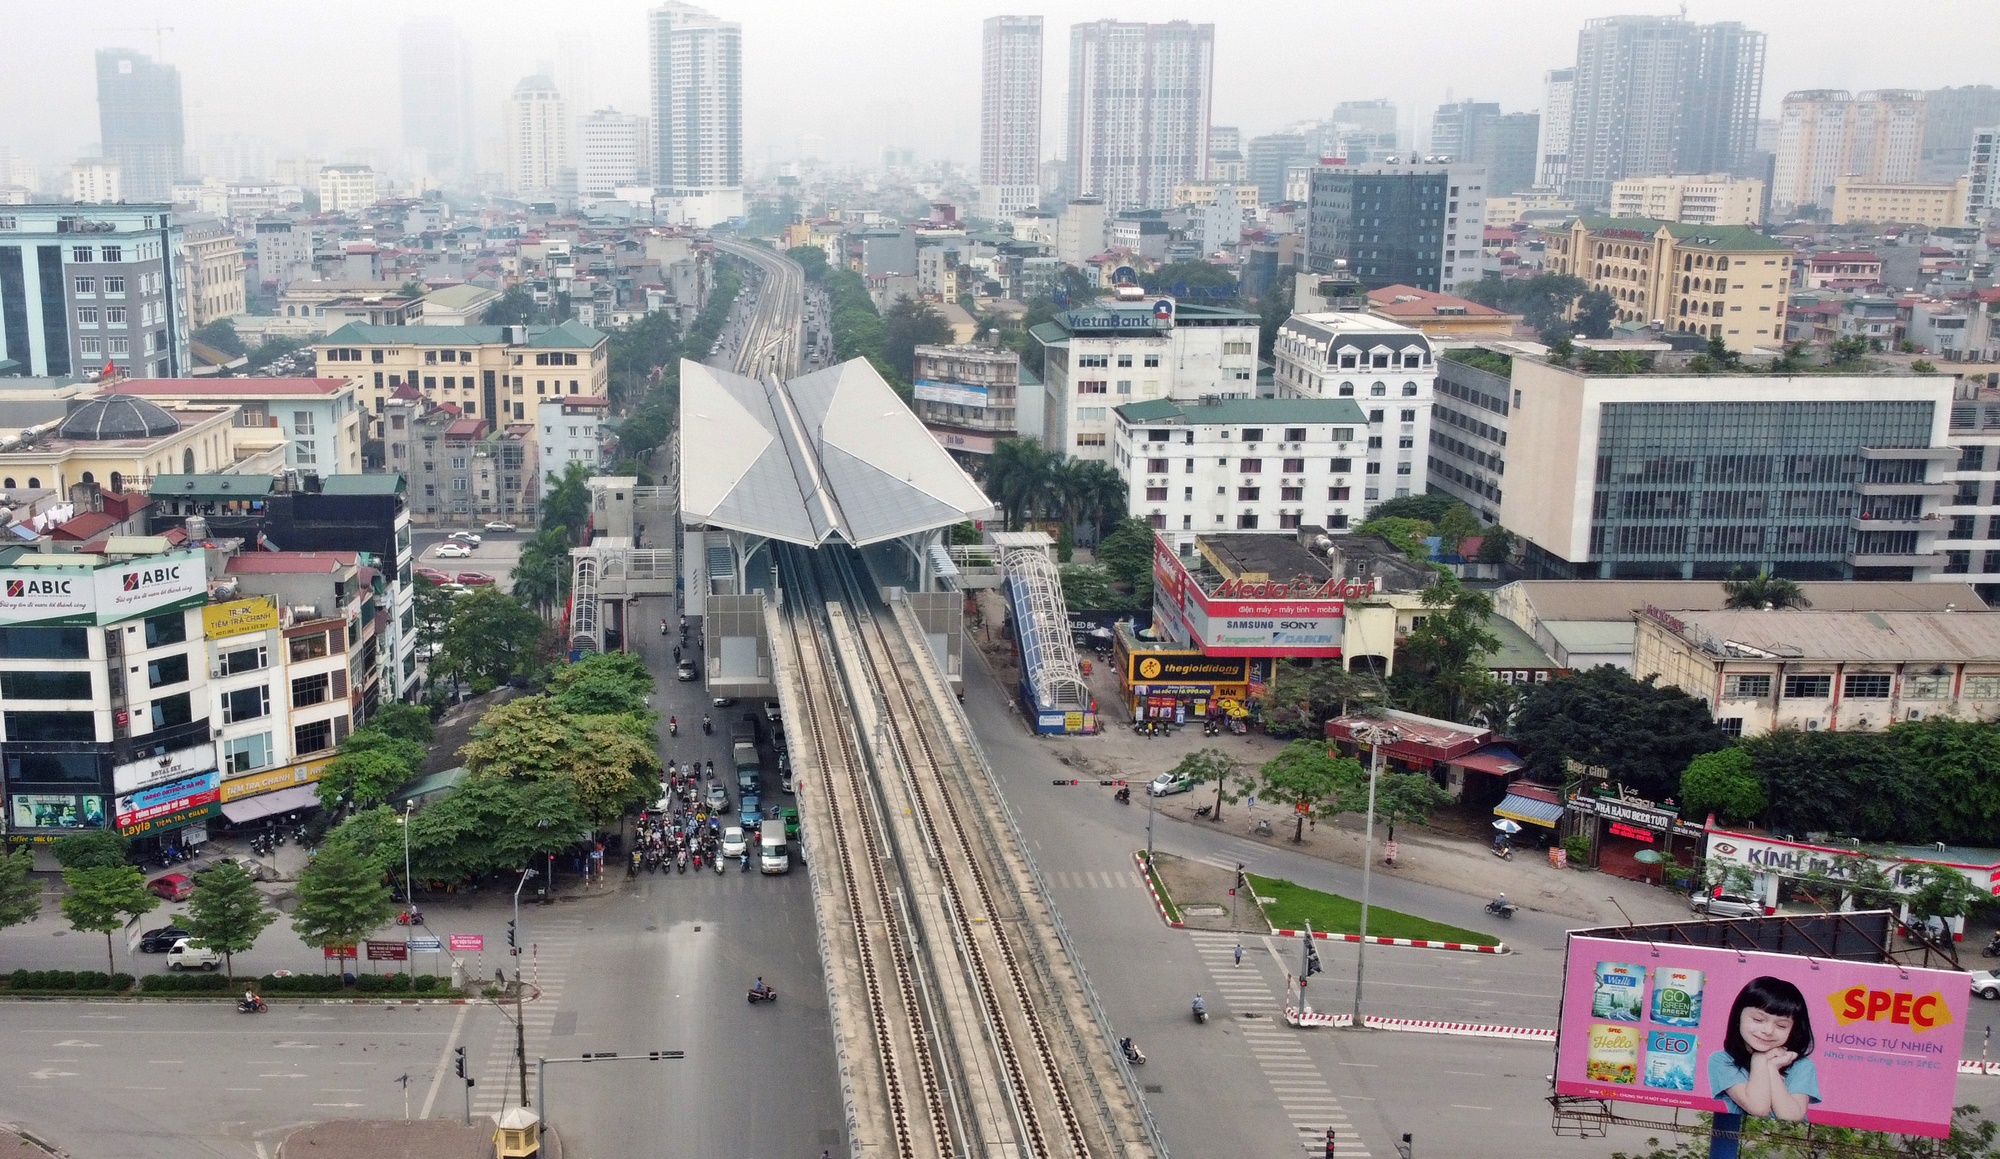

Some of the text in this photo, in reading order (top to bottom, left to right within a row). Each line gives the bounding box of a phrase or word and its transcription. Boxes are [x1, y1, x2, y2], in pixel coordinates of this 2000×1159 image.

[1068, 314, 1151, 327] VietinBank
[142, 566, 180, 585] ABIC
[28, 580, 71, 594] ABIC
[1210, 578, 1374, 599] Media Mart
[1238, 605, 1254, 614] điện
[1256, 606, 1272, 615] máy
[1279, 605, 1295, 615] máy
[1296, 606, 1310, 614] tính
[1317, 606, 1340, 614] mobile
[245, 613, 271, 623] CHANH
[1226, 620, 1318, 630] SAMSUNG SONY
[1087, 621, 1097, 630] 8K
[1284, 634, 1333, 644] DAIKIN
[1164, 663, 1240, 675] thegioididong
[1220, 687, 1236, 697] BÁN
[151, 768, 170, 778] ROYAL
[1567, 759, 1587, 775] Beer
[245, 779, 260, 790] TRÀ
[261, 774, 291, 786] CHANH
[1594, 802, 1611, 814] NHÀ
[1611, 806, 1632, 819] HÀNG
[1631, 808, 1651, 824] BEER
[122, 821, 151, 837] Layla
[188, 808, 209, 818] CHANH
[9, 835, 29, 843] Coffee
[1748, 846, 1801, 870] KÍNH
[1664, 989, 1685, 1003] GO
[1662, 1002, 1690, 1010] GREEN
[1842, 988, 1937, 1027] SPEC
[1593, 1035, 1634, 1049] Hello
[1655, 1037, 1689, 1053] CEO
[1825, 1033, 1943, 1054] HƯƠNG TỰ NHIÊN
